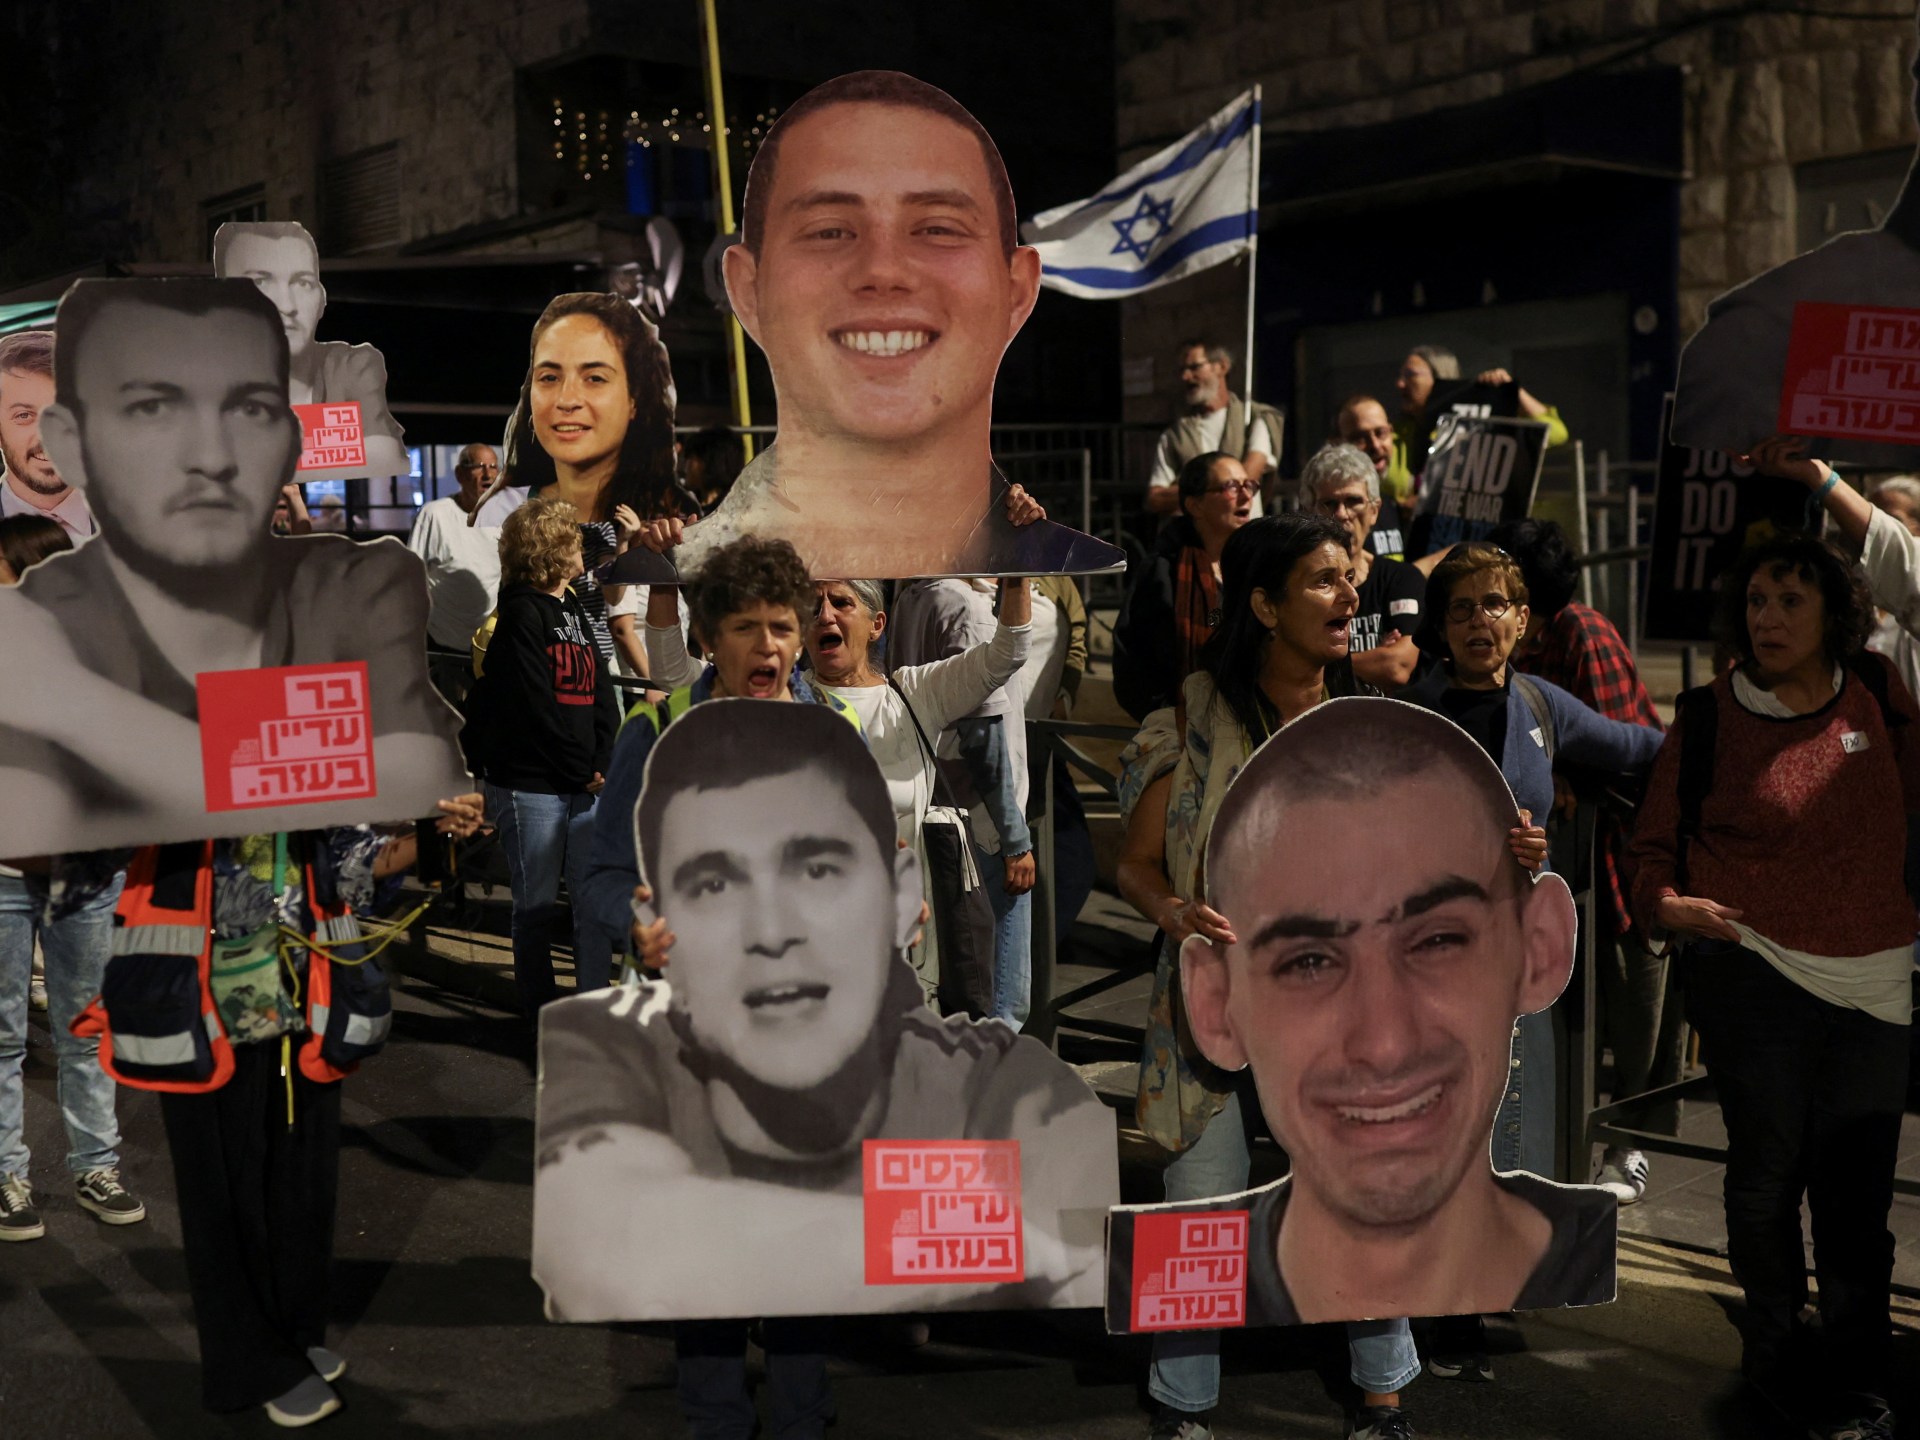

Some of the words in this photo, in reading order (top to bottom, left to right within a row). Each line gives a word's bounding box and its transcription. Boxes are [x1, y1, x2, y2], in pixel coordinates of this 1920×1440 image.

[328, 409, 356, 424] בר
[316, 427, 358, 446] עדיין
[308, 447, 361, 464] בעזה.
[1443, 432, 1519, 496] END
[1437, 488, 1466, 518] THE
[1465, 491, 1503, 524] WAR
[1681, 479, 1737, 535] DO
[296, 678, 357, 711] בר
[268, 717, 360, 757] עדיין
[247, 759, 366, 797] בעזה.
[927, 1195, 1010, 1229] עדיין
[1187, 1222, 1240, 1248] רום
[906, 1238, 1013, 1269] בעזה.
[1169, 1258, 1239, 1289] עדיין
[1149, 1294, 1239, 1322] בעזה.
